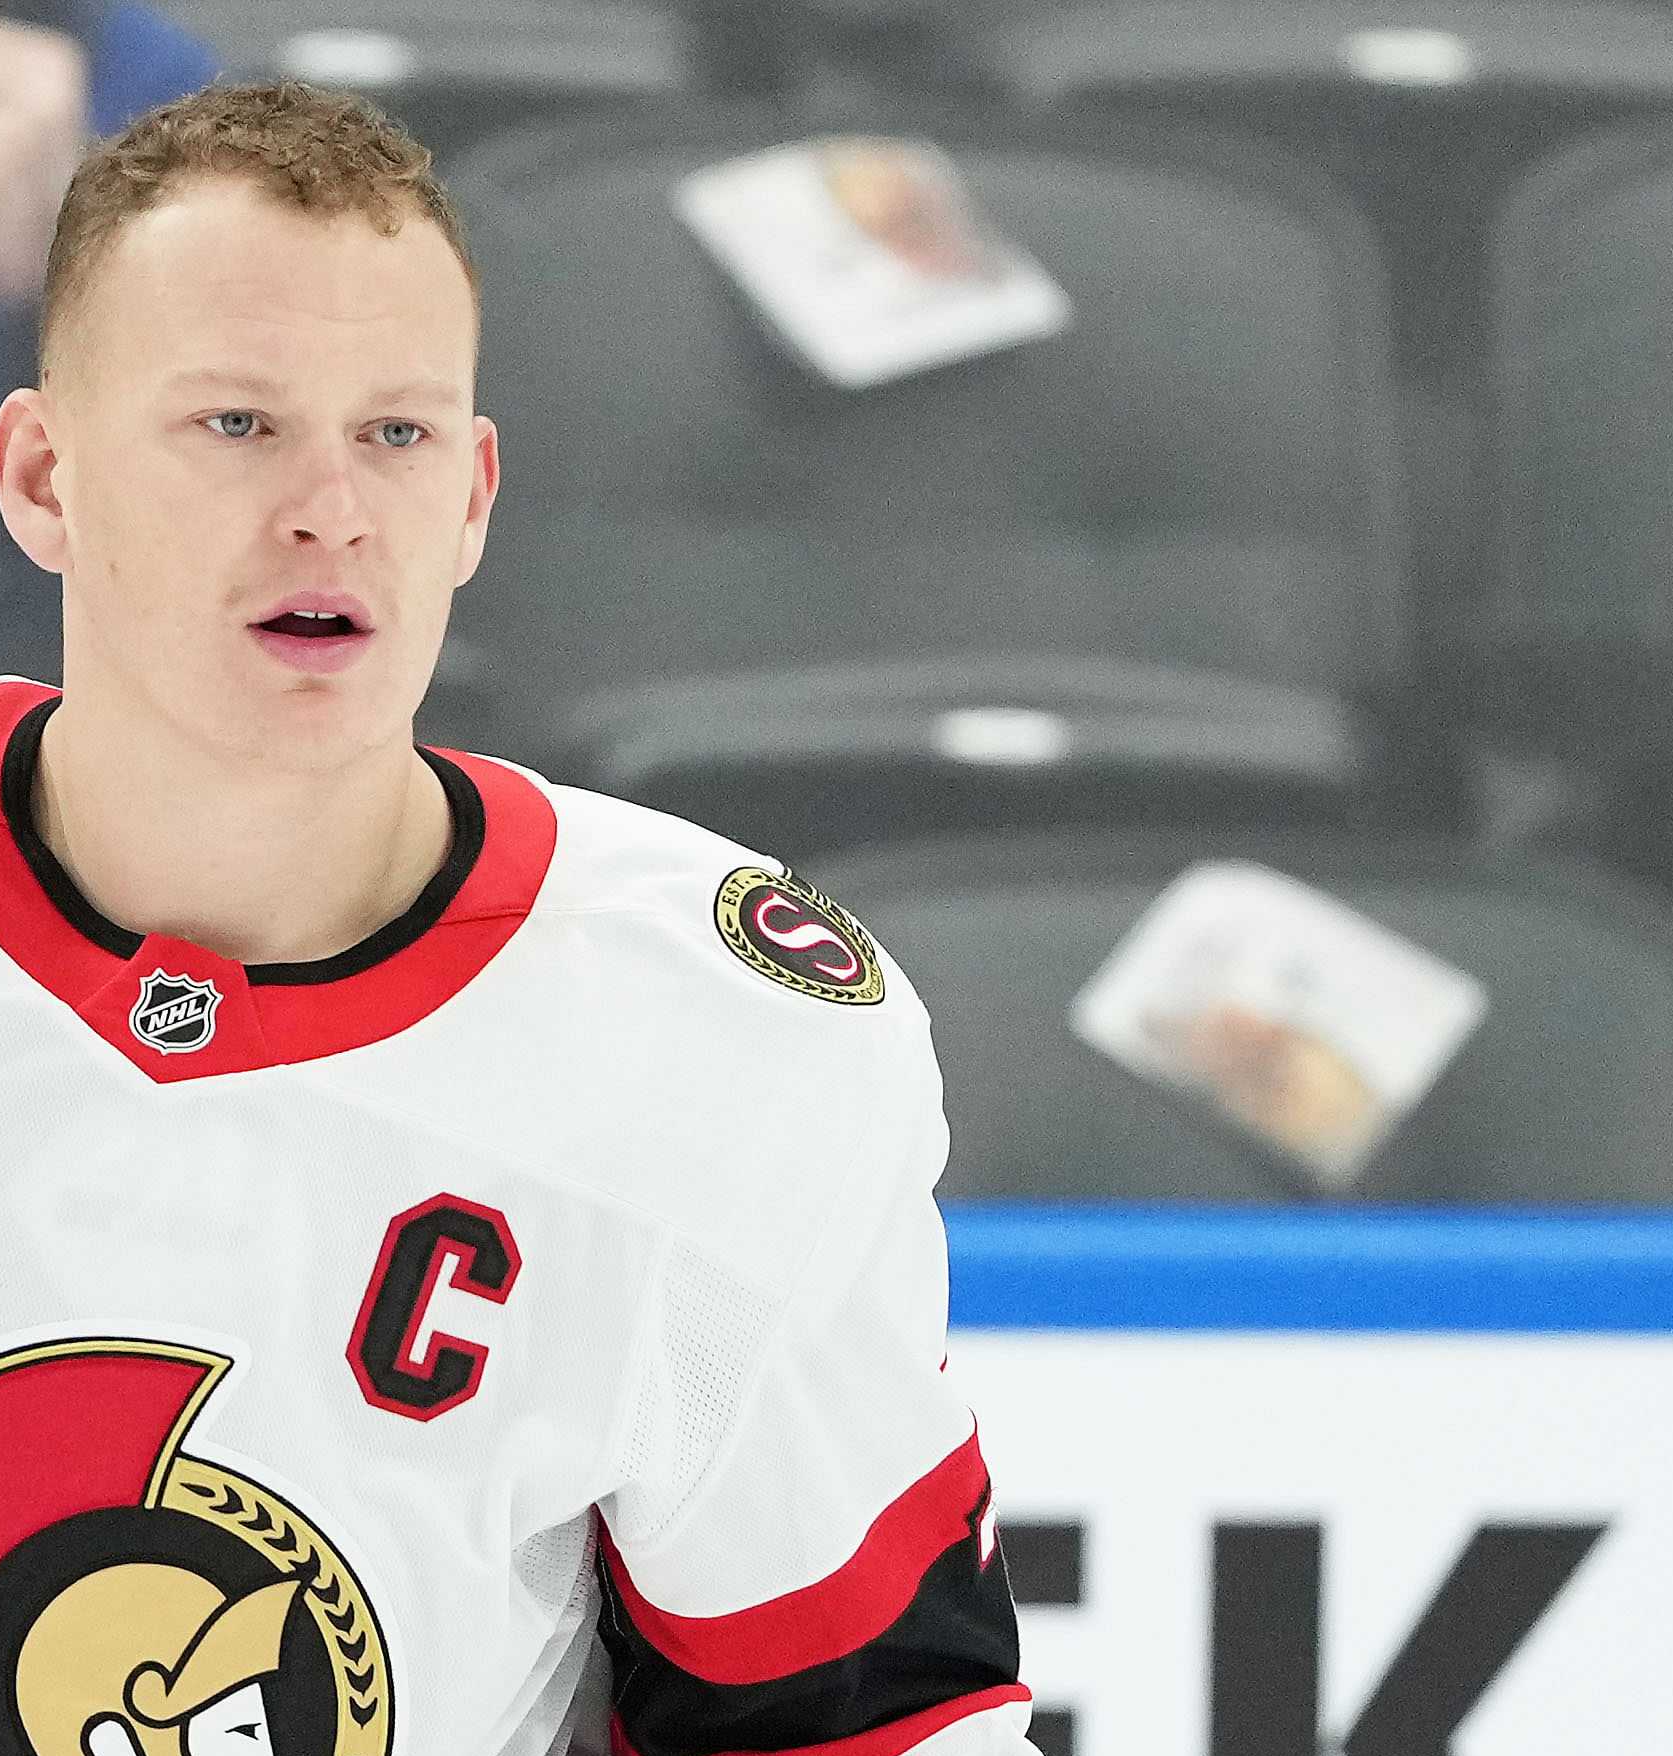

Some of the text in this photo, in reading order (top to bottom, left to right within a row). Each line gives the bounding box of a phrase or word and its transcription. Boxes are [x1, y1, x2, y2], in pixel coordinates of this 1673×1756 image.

[722, 877, 750, 907] EST.
[752, 889, 860, 983] S
[147, 998, 203, 1033] NHL
[345, 1191, 523, 1423] C
